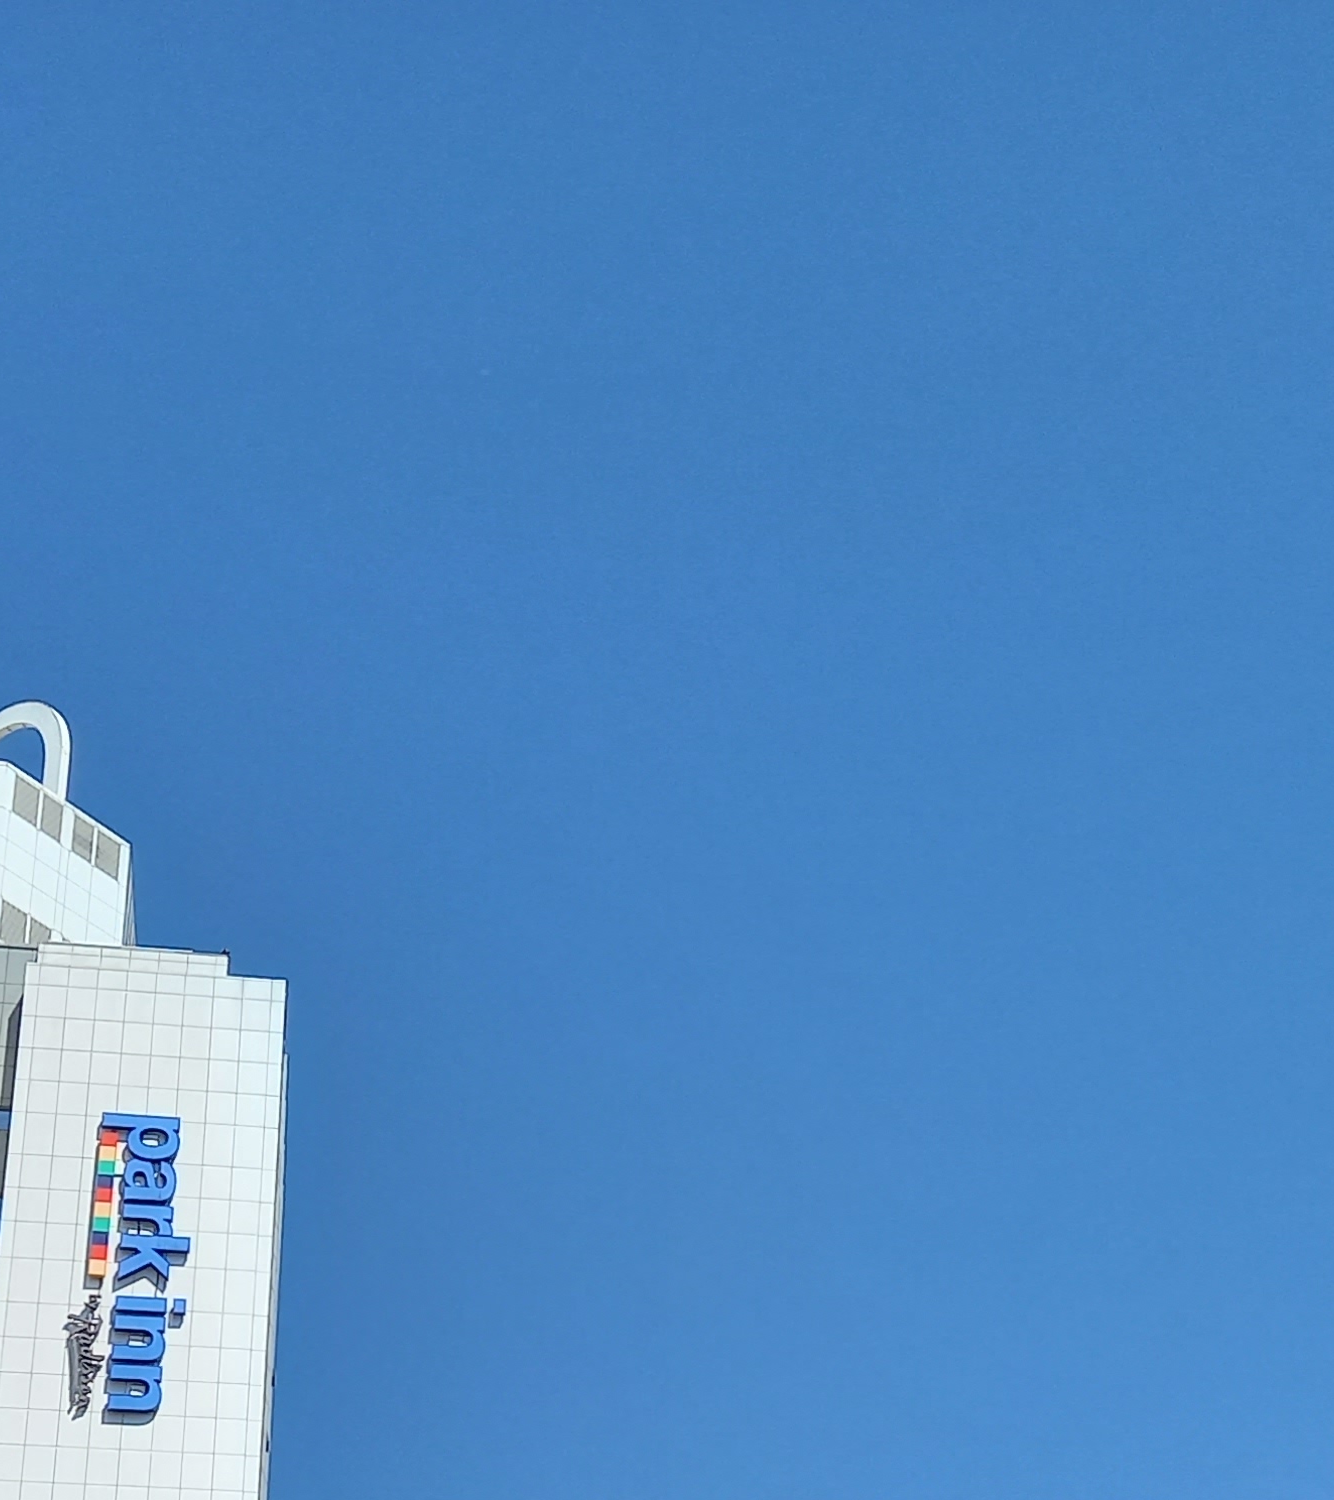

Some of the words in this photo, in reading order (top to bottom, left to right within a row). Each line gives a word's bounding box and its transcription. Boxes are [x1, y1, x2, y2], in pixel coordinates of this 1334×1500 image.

[99, 1112, 191, 1284] park
[61, 1312, 105, 1421] Radisson
[105, 1294, 186, 1412] inn
